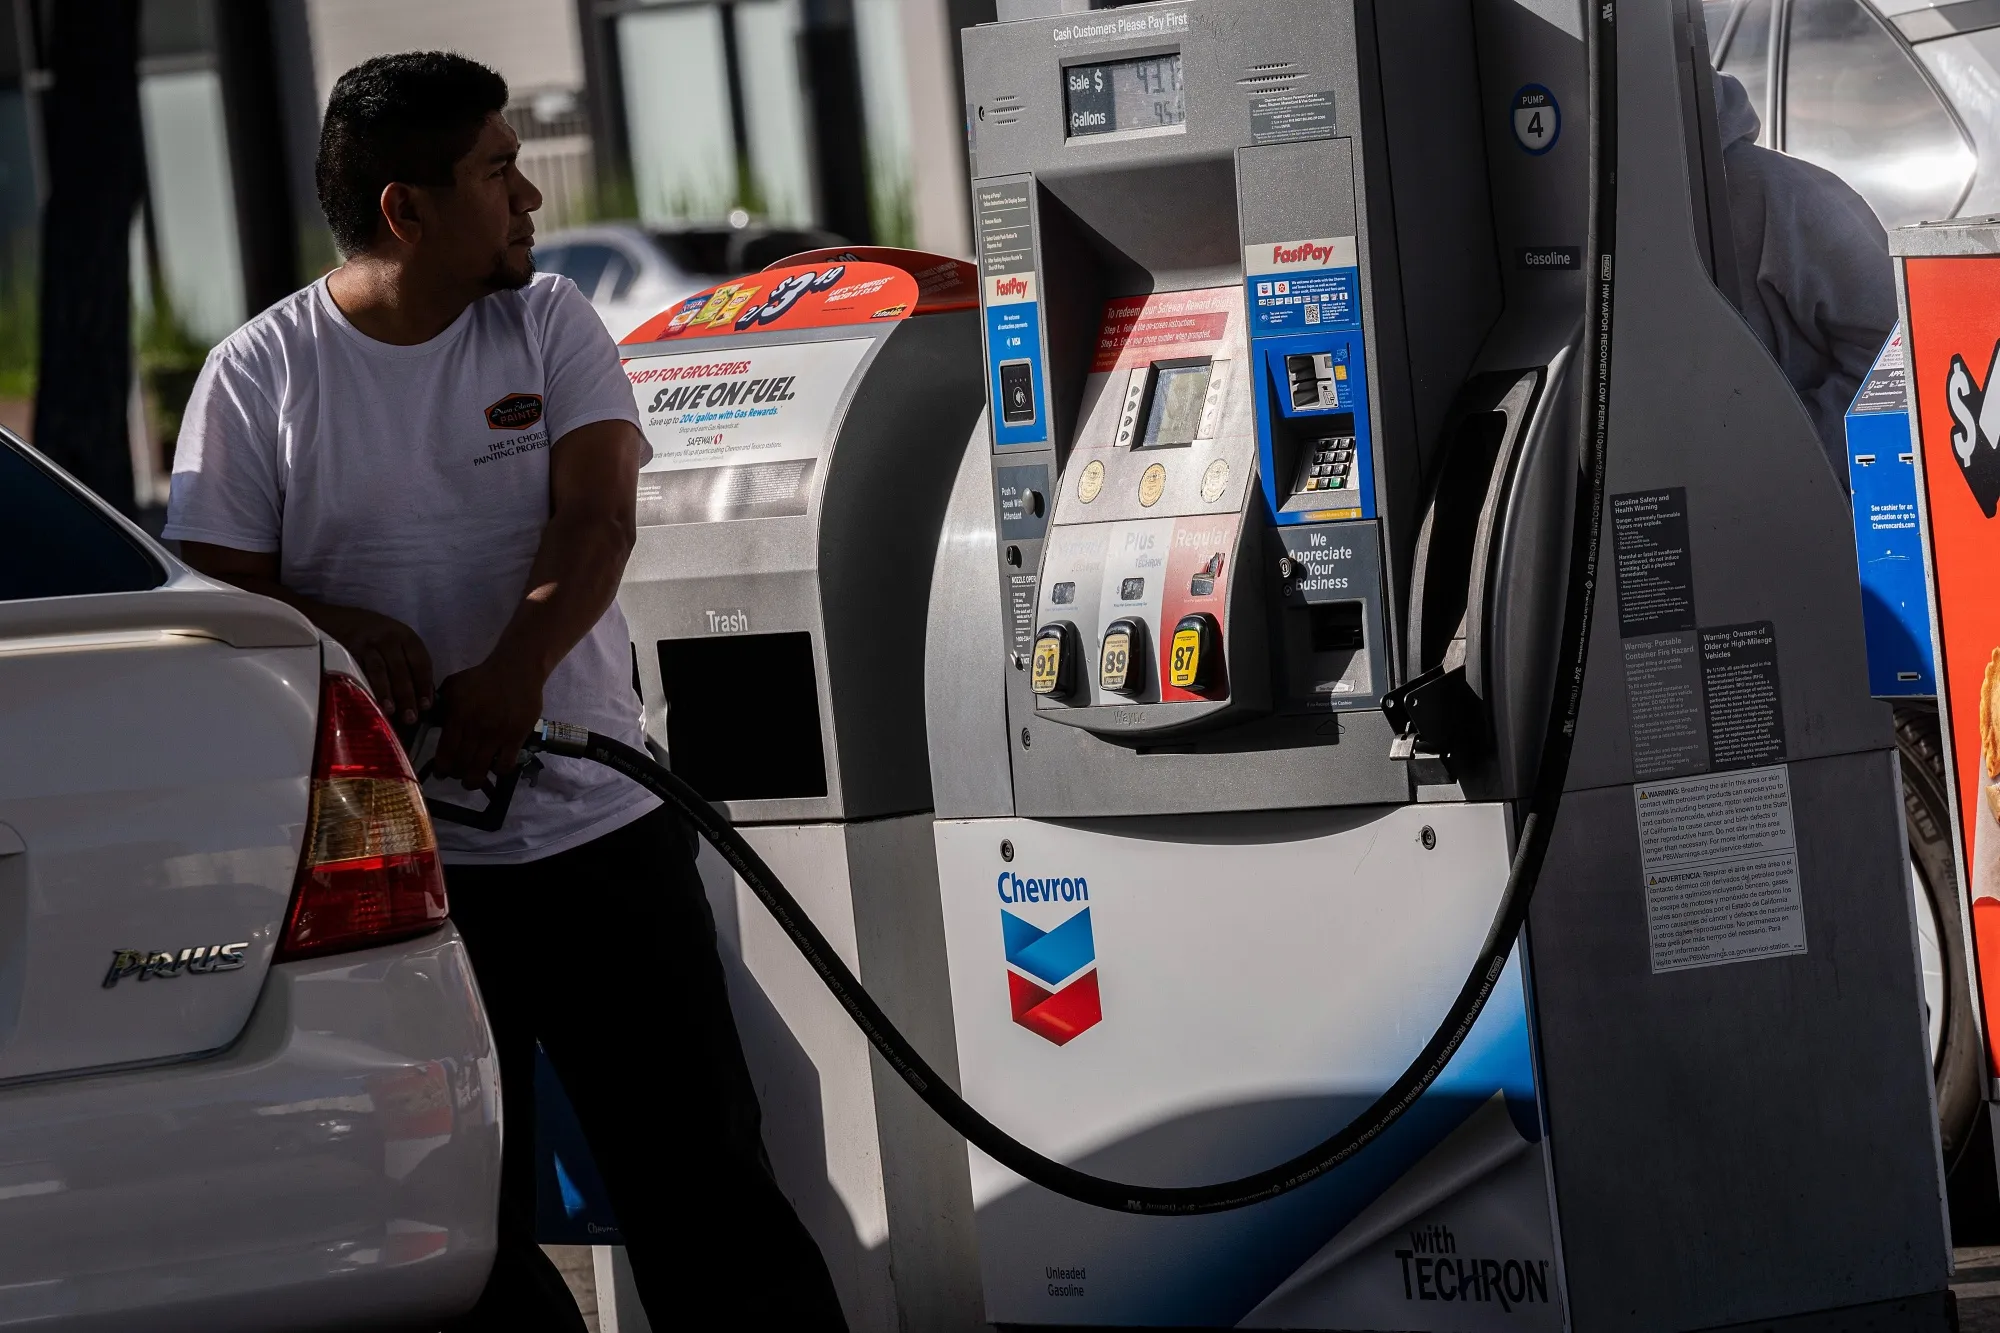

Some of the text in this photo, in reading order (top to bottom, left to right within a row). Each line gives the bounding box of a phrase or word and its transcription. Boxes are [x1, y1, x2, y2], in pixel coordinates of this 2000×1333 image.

[1054, 13, 1188, 41] Cash Customers Please Pay First
[1069, 68, 1103, 92] Sale $
[1522, 94, 1545, 105] PUMP
[1072, 111, 1106, 127] Gallons
[1527, 111, 1544, 138] 4
[1273, 243, 1335, 265] FastPay
[1525, 251, 1571, 265] Gasoline
[996, 277, 1028, 298] FastPay
[1107, 308, 1115, 319] To
[1115, 306, 1140, 318] redeem
[1157, 302, 1185, 315] Safeway
[1601, 284, 1610, 331] HW-VAPOR
[1104, 324, 1116, 335] Step
[1101, 338, 1113, 348] Step
[1599, 333, 1608, 381] RECOVERY
[653, 367, 683, 382] FOR
[681, 360, 752, 380] GROCERIES.
[647, 375, 797, 414] SAVE ON FUEL.
[1598, 382, 1606, 402] LOW
[500, 408, 538, 425] PAINTS
[648, 417, 663, 427] Save
[664, 417, 672, 426] up
[672, 416, 679, 424] to
[718, 410, 733, 420] with
[734, 409, 747, 419] Gas
[1597, 405, 1606, 430] PERM
[488, 441, 505, 453] THE
[686, 435, 715, 447] SAFEWAY
[473, 447, 515, 467] PAINTING
[1001, 486, 1017, 496] Push To
[1614, 498, 1638, 506] Gasoline
[1639, 495, 1657, 504] Safety
[1634, 503, 1657, 512] Warning
[1870, 504, 1880, 512] See
[1589, 492, 1600, 536] GASOLINE
[1870, 513, 1896, 522] application
[1872, 522, 1915, 530] Chevroncards.com
[1124, 532, 1155, 551] Plus
[1175, 529, 1228, 549] Regular
[1310, 533, 1327, 547] We
[1289, 546, 1352, 564] Appreciate
[1587, 538, 1597, 563] HOSE
[1307, 562, 1334, 576] Your
[1585, 563, 1595, 577] BY
[1295, 576, 1348, 591] Business
[705, 609, 748, 632] Trash
[1703, 631, 1731, 641] Warning:
[1732, 628, 1757, 637] Owners
[1704, 642, 1721, 650] Older
[1730, 636, 1772, 648] High-Mileage
[1624, 637, 1681, 651] Warning: Portable
[1625, 645, 1694, 660] Container Fire Hazard
[1104, 650, 1127, 674] 89
[1174, 645, 1195, 671] 87
[1705, 650, 1730, 659] Vehicles
[1035, 653, 1056, 677] 91
[1113, 710, 1146, 727] Wayne
[1648, 788, 1679, 798] WARNING:
[1680, 784, 1708, 794] Breathing
[1709, 782, 1718, 790] the
[1735, 778, 1746, 786] this
[1747, 776, 1759, 784] area
[1649, 825, 1677, 834] California
[1703, 819, 1722, 827] cancer
[1749, 812, 1770, 820] defects
[1658, 871, 1701, 883] ADVERTENCIA:
[1703, 868, 1726, 877] Respirar
[997, 871, 1089, 904] Chevron
[102, 942, 249, 989] PRIUS
[1435, 1023, 1468, 1066] RECOVERY
[1421, 1065, 1439, 1084] LOW
[1403, 1083, 1424, 1105] PERM
[1320, 1142, 1359, 1171] GASOLINE
[1297, 1165, 1321, 1183] HOSE
[1410, 1225, 1456, 1254] with
[1045, 1266, 1087, 1280] Unleaded
[1047, 1283, 1085, 1297] Gasoline
